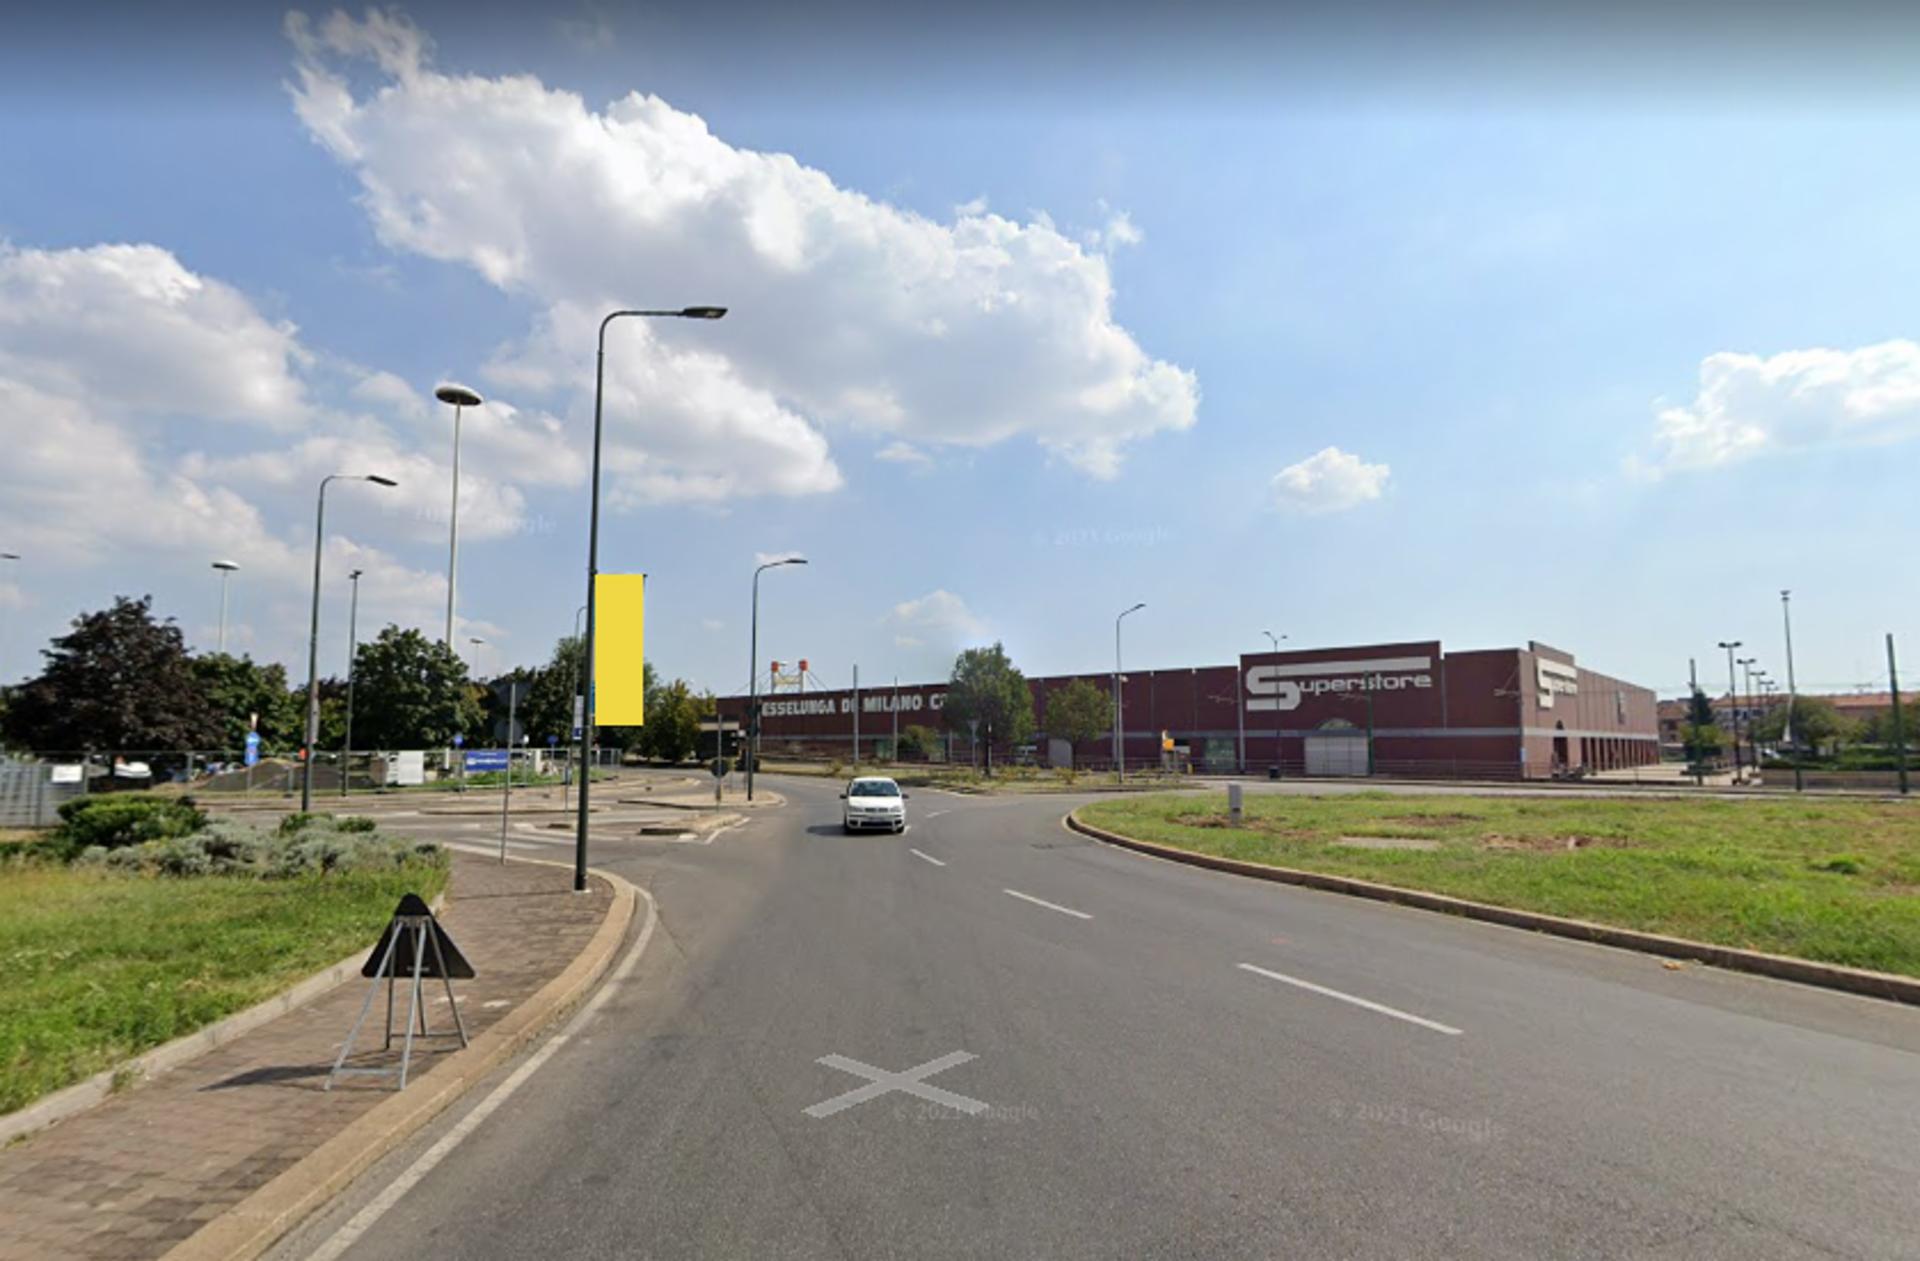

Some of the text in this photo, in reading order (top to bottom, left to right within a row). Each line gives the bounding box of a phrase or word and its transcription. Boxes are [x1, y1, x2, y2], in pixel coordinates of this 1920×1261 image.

[1246, 656, 1432, 710] Superstore
[761, 698, 836, 717] ESSELUNGA
[863, 693, 923, 713] MILANO
